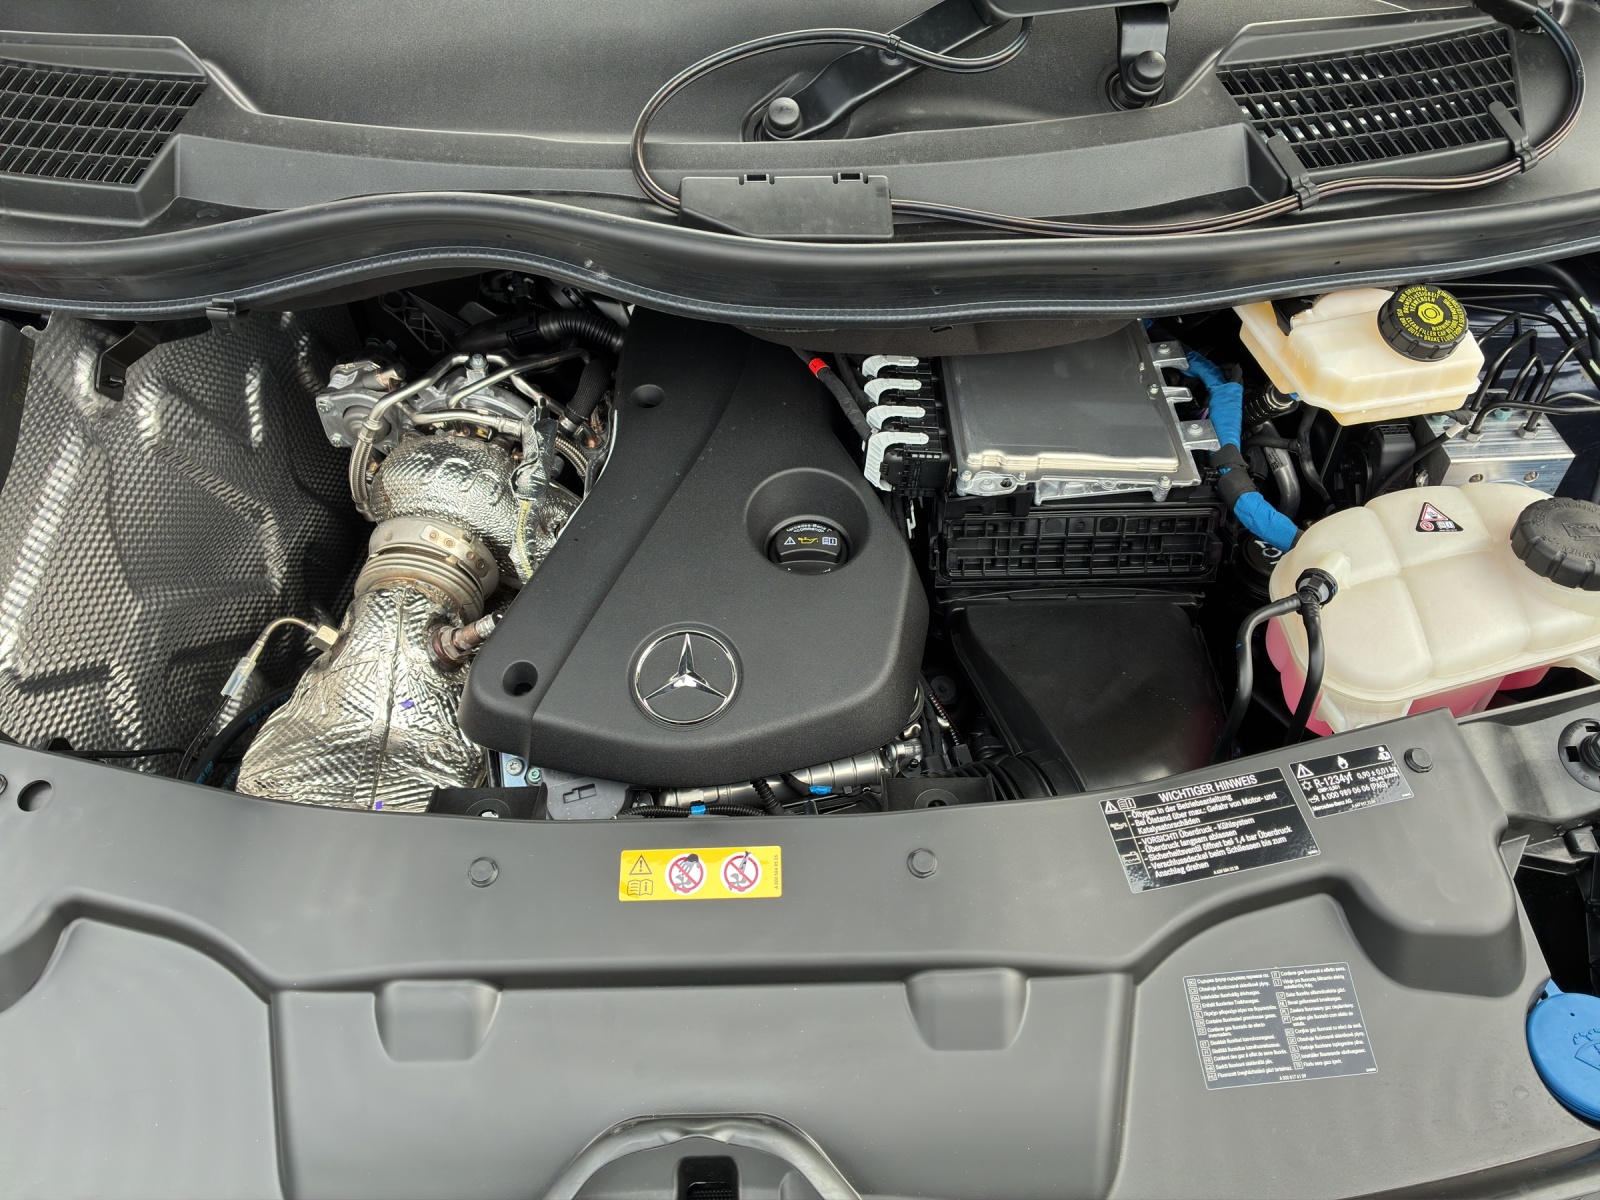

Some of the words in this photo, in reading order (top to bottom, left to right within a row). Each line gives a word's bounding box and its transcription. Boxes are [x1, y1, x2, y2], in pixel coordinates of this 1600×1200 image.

[1158, 784, 1215, 802] WICHTIGER
[1214, 774, 1258, 791] HINWEIS
[1313, 772, 1353, 788] R-1234yf
[1356, 771, 1371, 779] 0,90
[1326, 791, 1339, 799] 000
[1339, 788, 1351, 796] 989
[1130, 806, 1157, 818] Öltypen
[1176, 794, 1233, 810] Betriebsanleitung
[1134, 818, 1146, 826] Bei
[1146, 814, 1172, 824] Ölstand
[1172, 812, 1187, 820] über
[1206, 803, 1228, 812] Gefahr
[1264, 792, 1277, 801] und
[1137, 818, 1202, 837] Katalysatorschäden
[1178, 825, 1214, 838] Überdruck
[1217, 818, 1255, 830] Kühlsystem
[1144, 841, 1180, 853] Überdruck
[1179, 836, 1208, 846] langsam
[1208, 830, 1237, 840] ablassen
[1148, 844, 1202, 861] Sicherheitsventil
[1202, 841, 1223, 850] öffnet
[1222, 838, 1234, 846] bei
[1234, 836, 1246, 844] 1,4
[1257, 826, 1292, 839] Überdruck
[1208, 849, 1226, 858] beim
[1155, 867, 1186, 878] Anschlag
[1185, 862, 1209, 872] drehen
